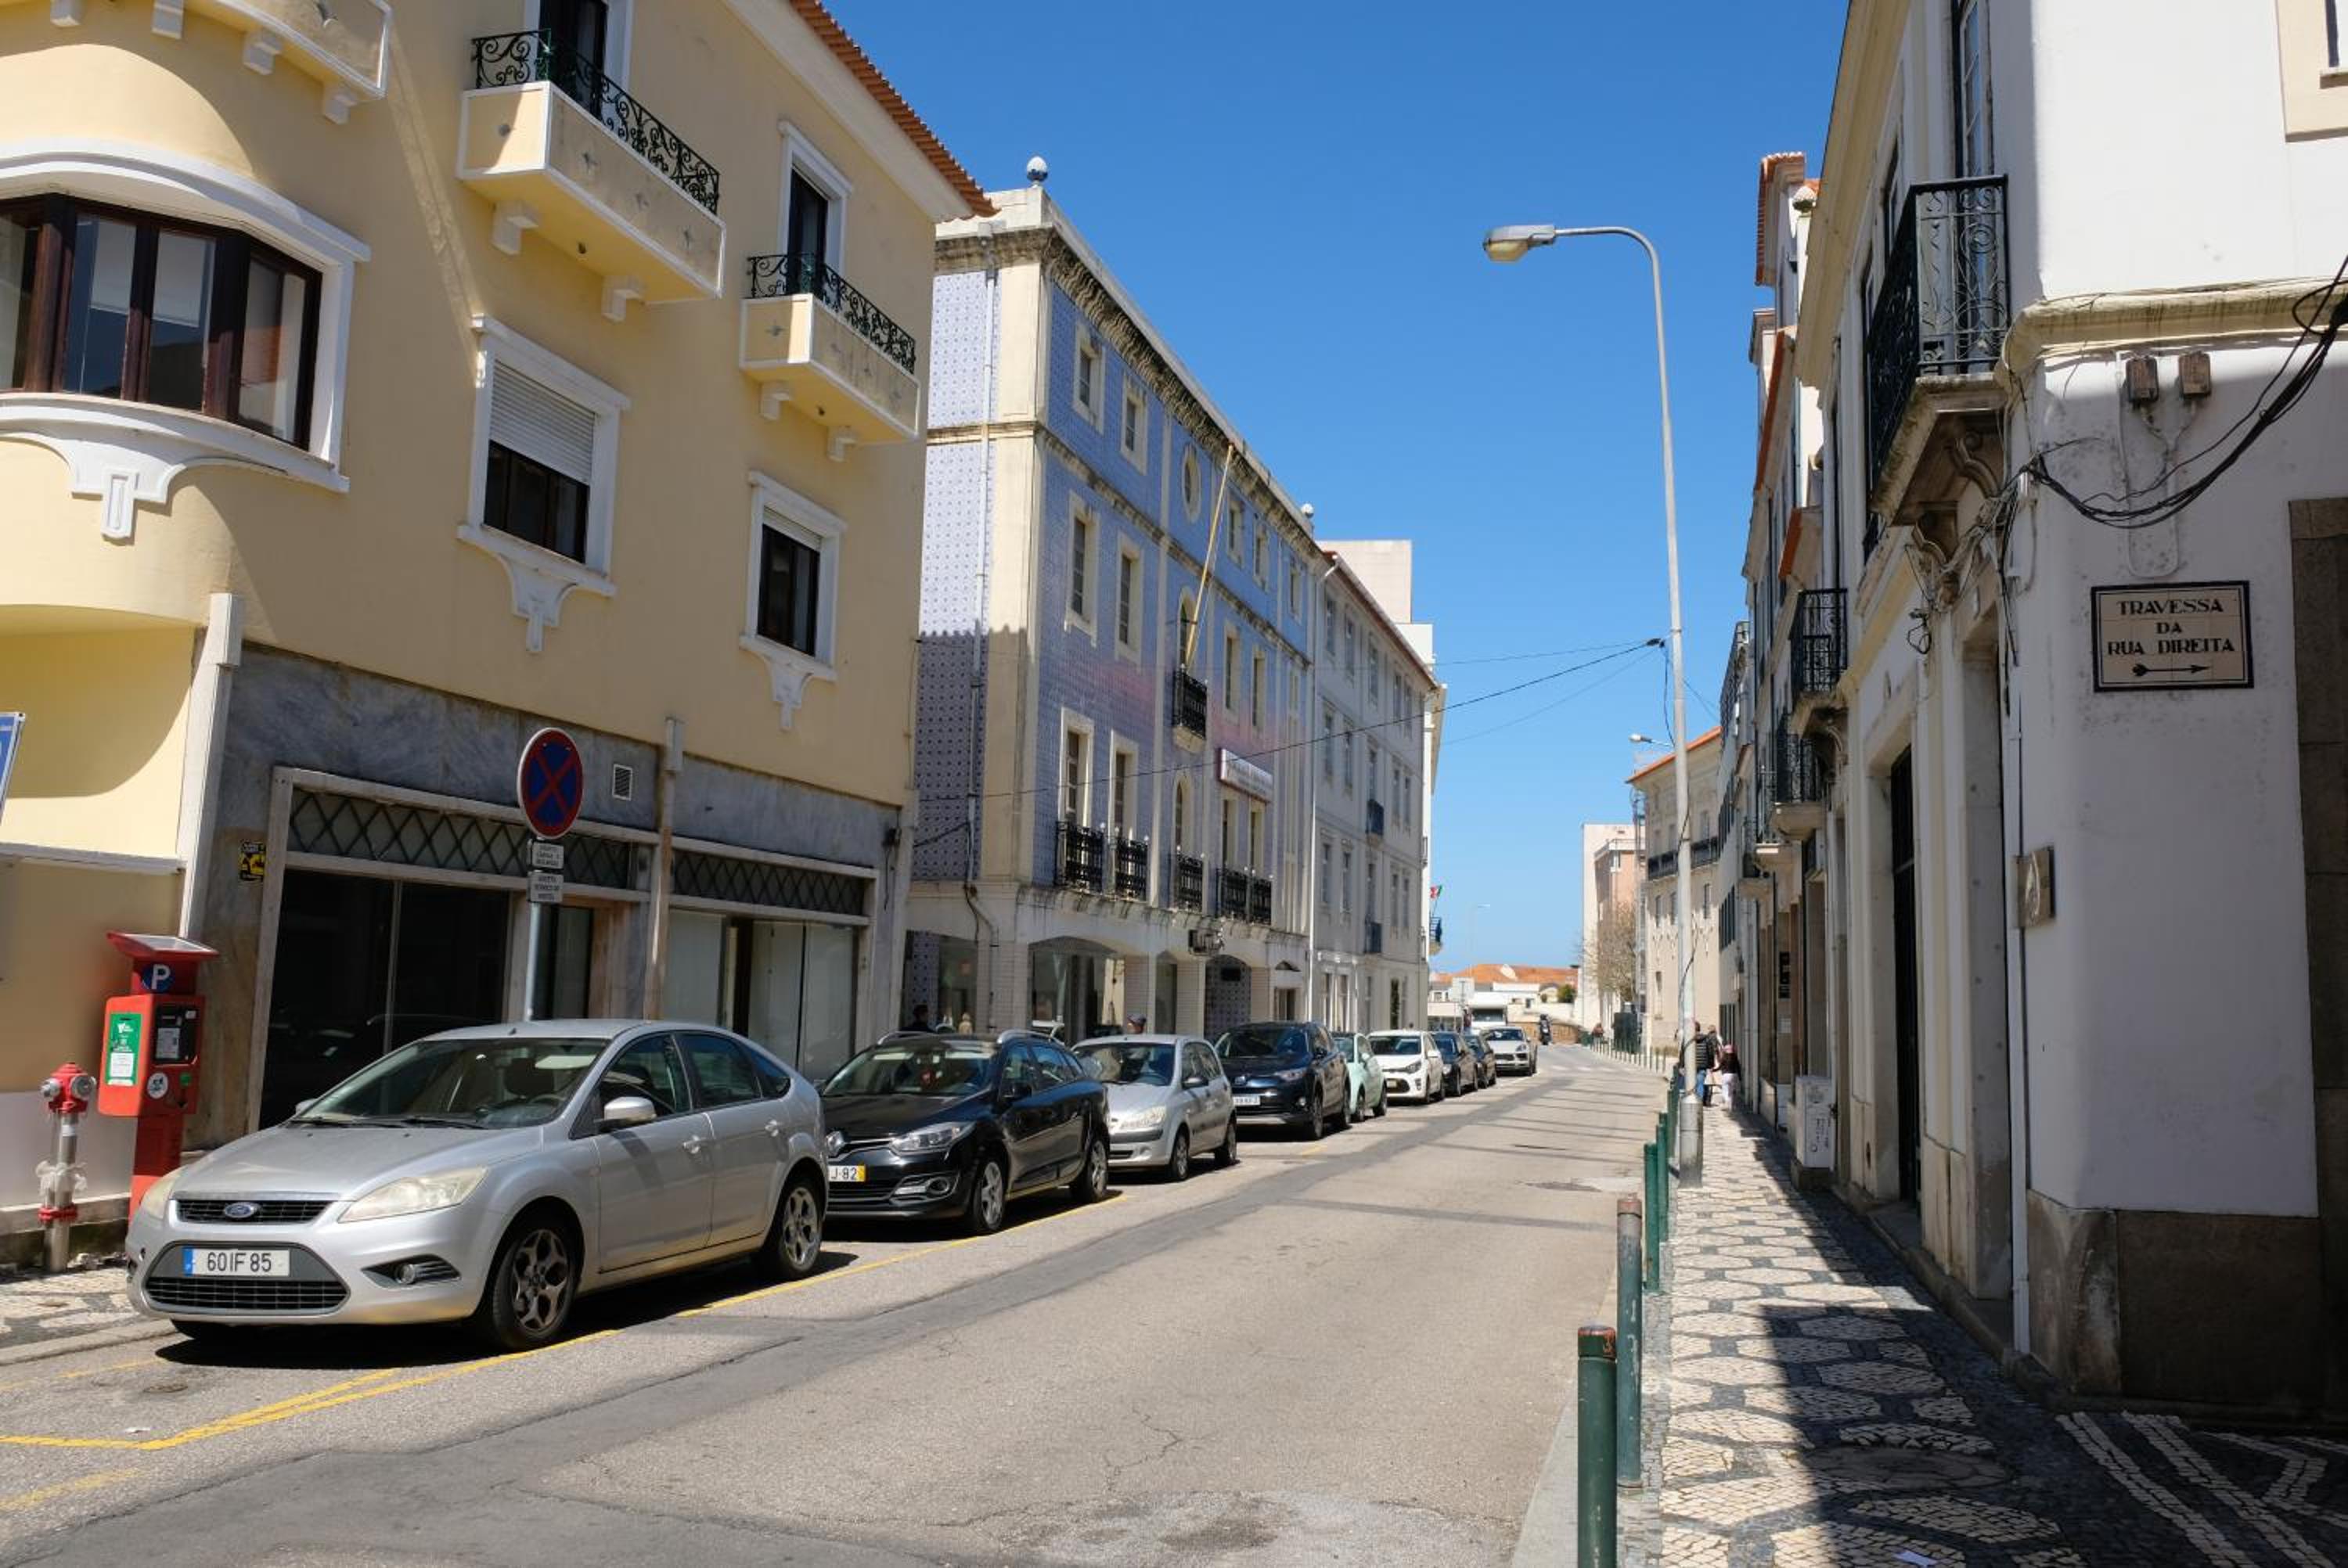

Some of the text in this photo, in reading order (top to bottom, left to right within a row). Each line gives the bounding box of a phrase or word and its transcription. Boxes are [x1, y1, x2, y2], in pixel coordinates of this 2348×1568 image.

[2116, 599, 2224, 616] TRAVESSA
[2155, 622, 2183, 635] DA
[2107, 638, 2235, 656] RUA DIREITA
[151, 963, 171, 990] P
